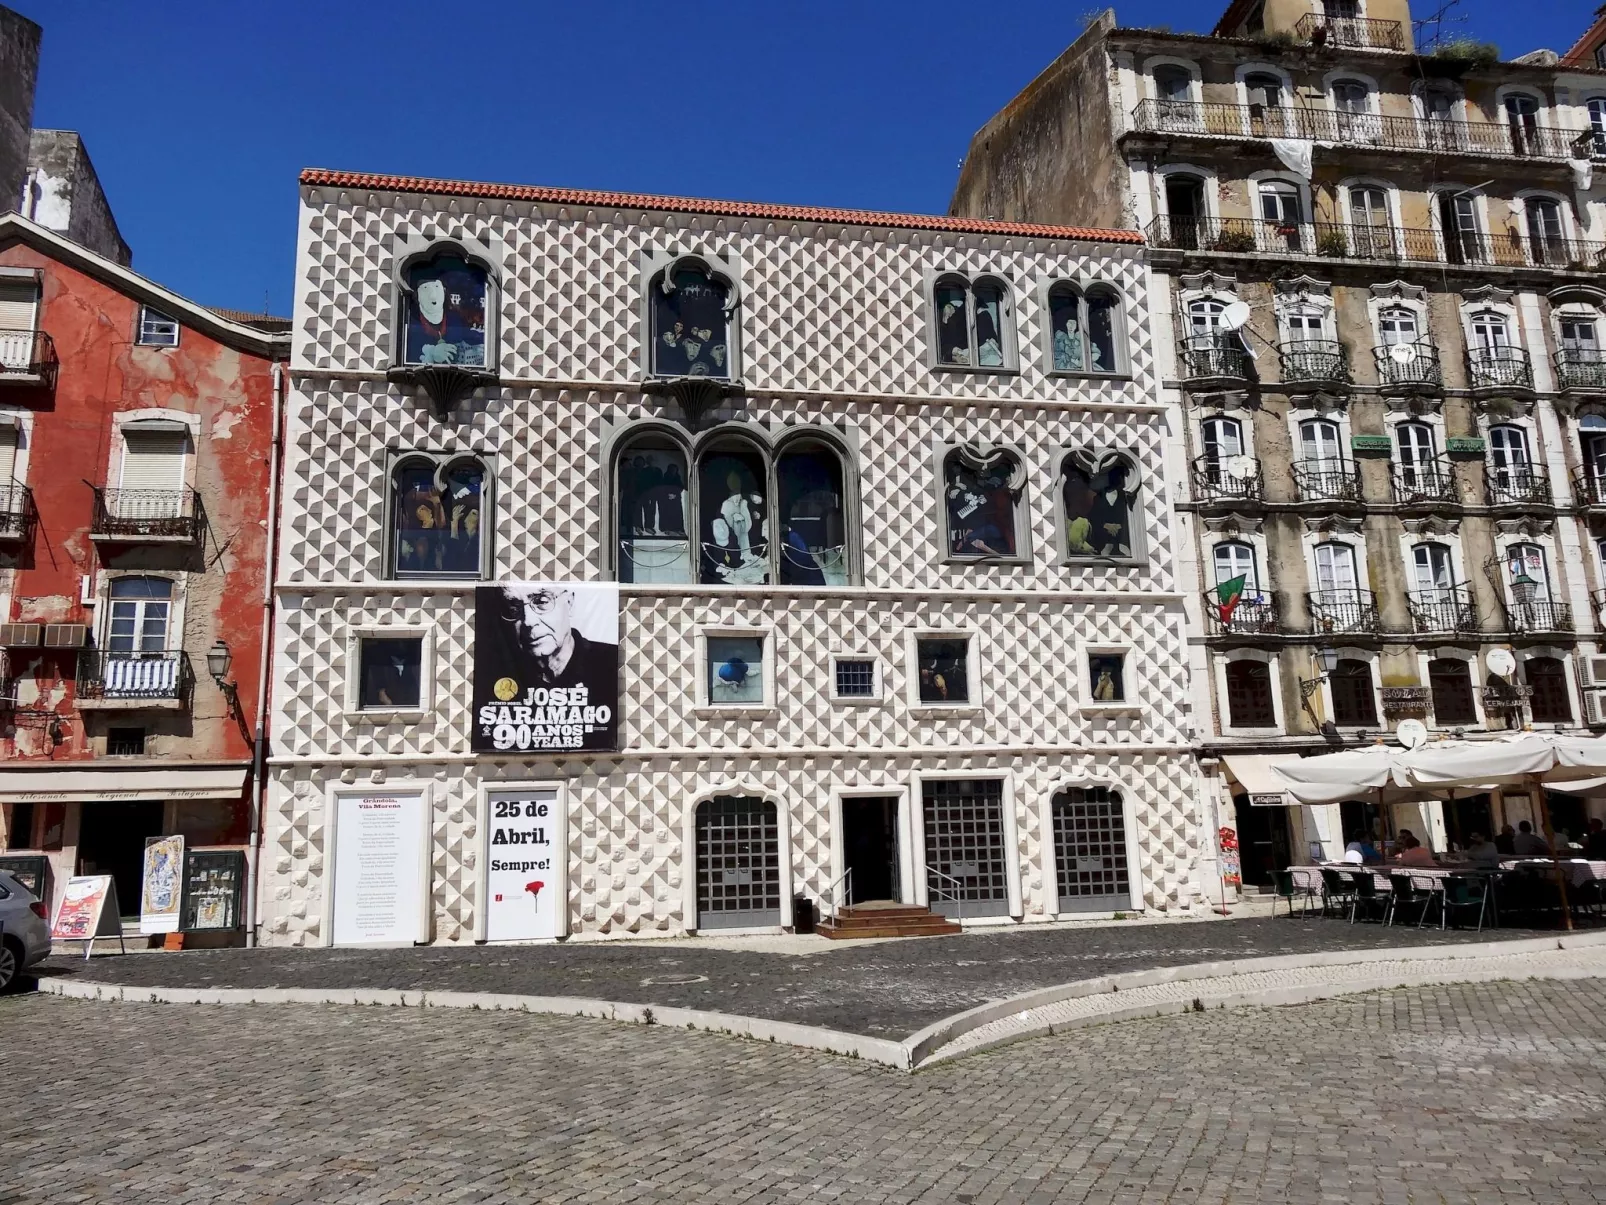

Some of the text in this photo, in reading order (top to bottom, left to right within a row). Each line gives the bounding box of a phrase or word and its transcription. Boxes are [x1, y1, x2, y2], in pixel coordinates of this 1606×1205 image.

[523, 682, 589, 706] JOSÉ
[479, 705, 612, 725] SARAMAGO
[493, 724, 532, 750] 90
[532, 725, 584, 737] ANOS
[532, 736, 584, 748] YEARS
[495, 801, 549, 818] 25 de
[492, 828, 550, 846] Abril,
[491, 858, 550, 873] Sempre!
